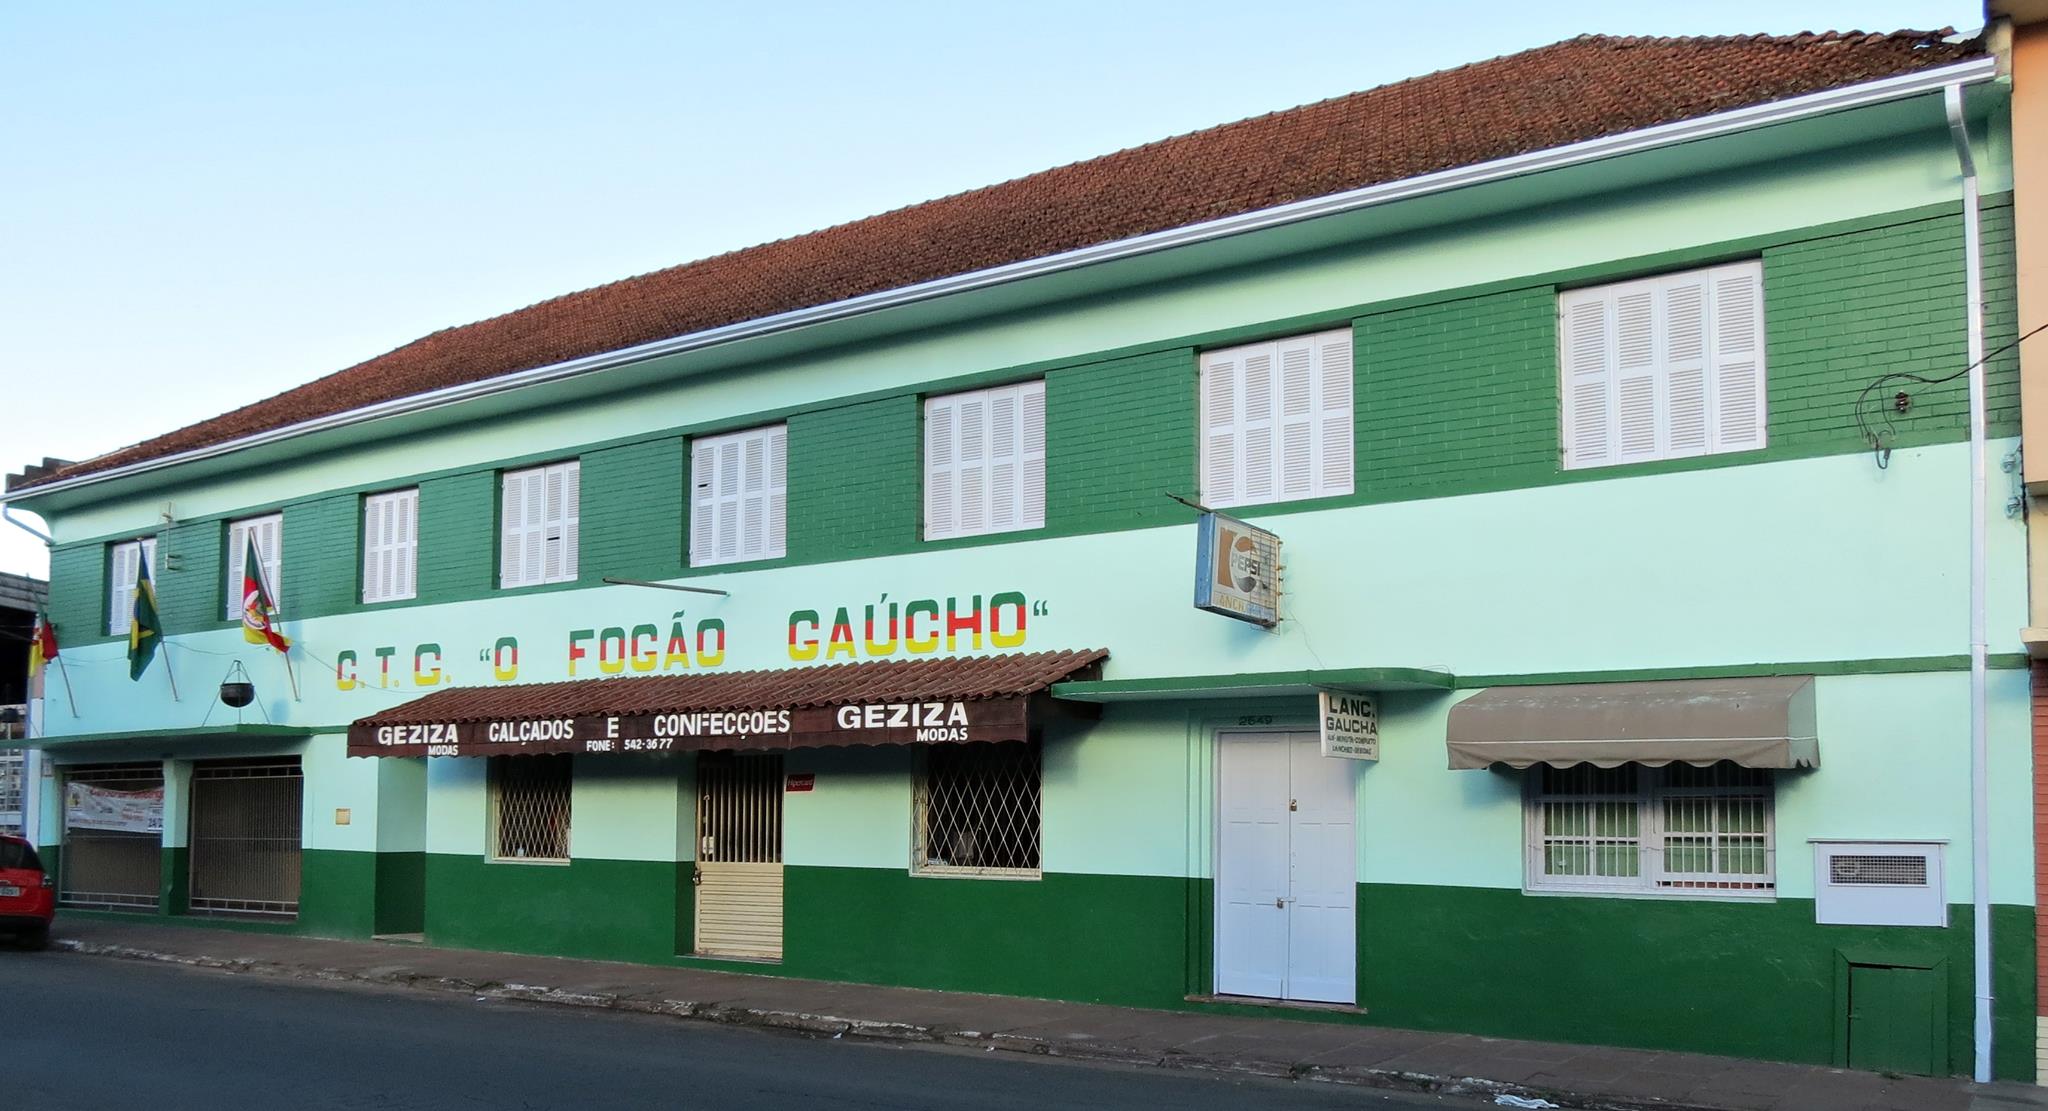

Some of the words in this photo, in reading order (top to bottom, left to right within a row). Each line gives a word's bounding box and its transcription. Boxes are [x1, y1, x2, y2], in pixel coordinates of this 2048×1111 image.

[1231, 552, 1260, 576] PEPSI
[568, 609, 725, 677] FOGÃO
[1328, 695, 1376, 718] LANC.
[377, 724, 459, 746] GEZIZA
[489, 719, 575, 746] CALÇADOS
[606, 717, 620, 738] E
[836, 702, 969, 729] GEZIZA
[916, 726, 969, 742] MODAS
[1326, 716, 1378, 735] GAUCHA
[427, 744, 459, 757] MODAS
[586, 739, 615, 752] FONE:
